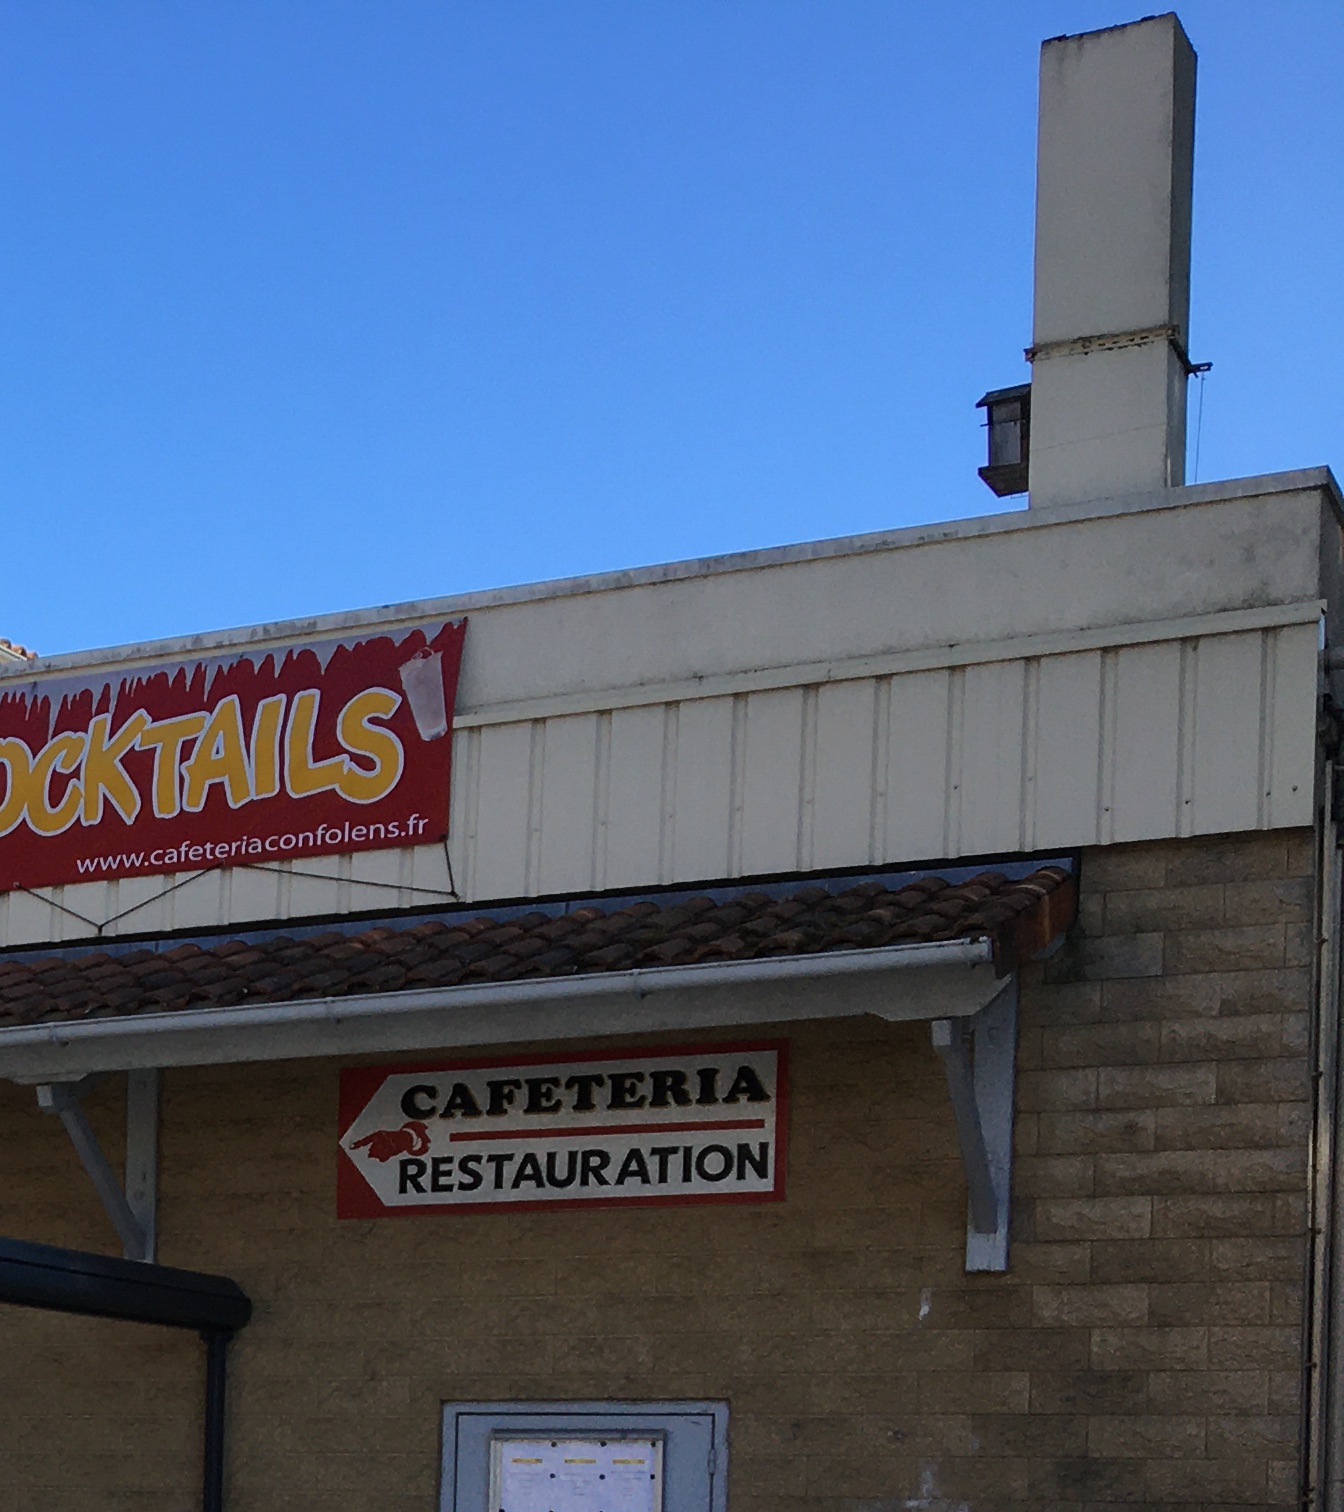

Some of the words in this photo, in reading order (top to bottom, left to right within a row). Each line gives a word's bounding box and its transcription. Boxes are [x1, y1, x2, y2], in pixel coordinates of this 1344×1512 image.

[76, 813, 429, 874] www.cafeteriaconfolens.fr
[401, 1065, 771, 1121] CAFETERIA
[398, 1141, 770, 1195] RESTAURATION
